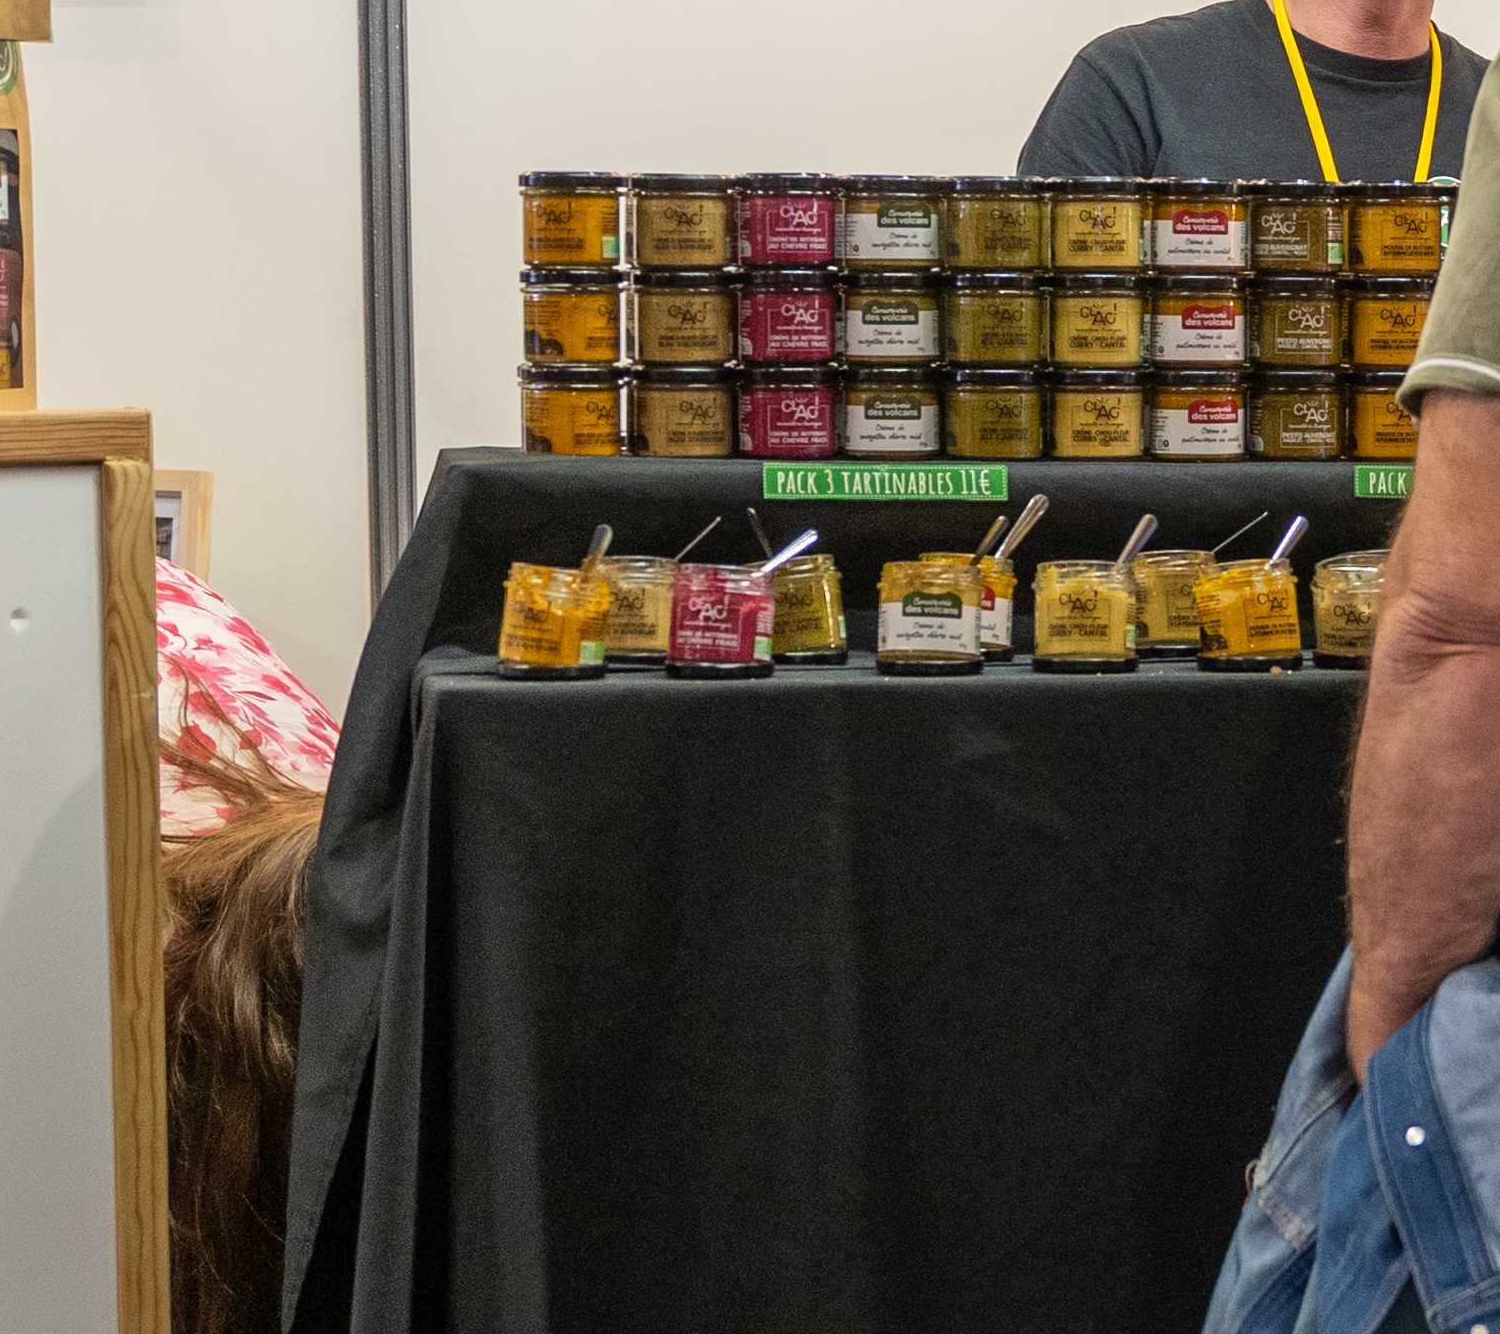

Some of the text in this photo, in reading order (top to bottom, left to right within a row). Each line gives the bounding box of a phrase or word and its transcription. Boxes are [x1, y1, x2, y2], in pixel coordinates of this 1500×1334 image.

[1079, 206, 1116, 230] CLAC!
[1176, 222, 1226, 232] des volcans
[1262, 212, 1297, 234] CLAC!
[1080, 303, 1118, 327] CLAC!
[1289, 306, 1325, 329] CLAC!
[1083, 397, 1121, 421] CLAC!
[1294, 400, 1329, 423] CLAC!
[777, 469, 992, 495] PACK 3 TARTINABLES 11€
[1369, 471, 1408, 496] PACK
[1059, 590, 1098, 613] CLAC!
